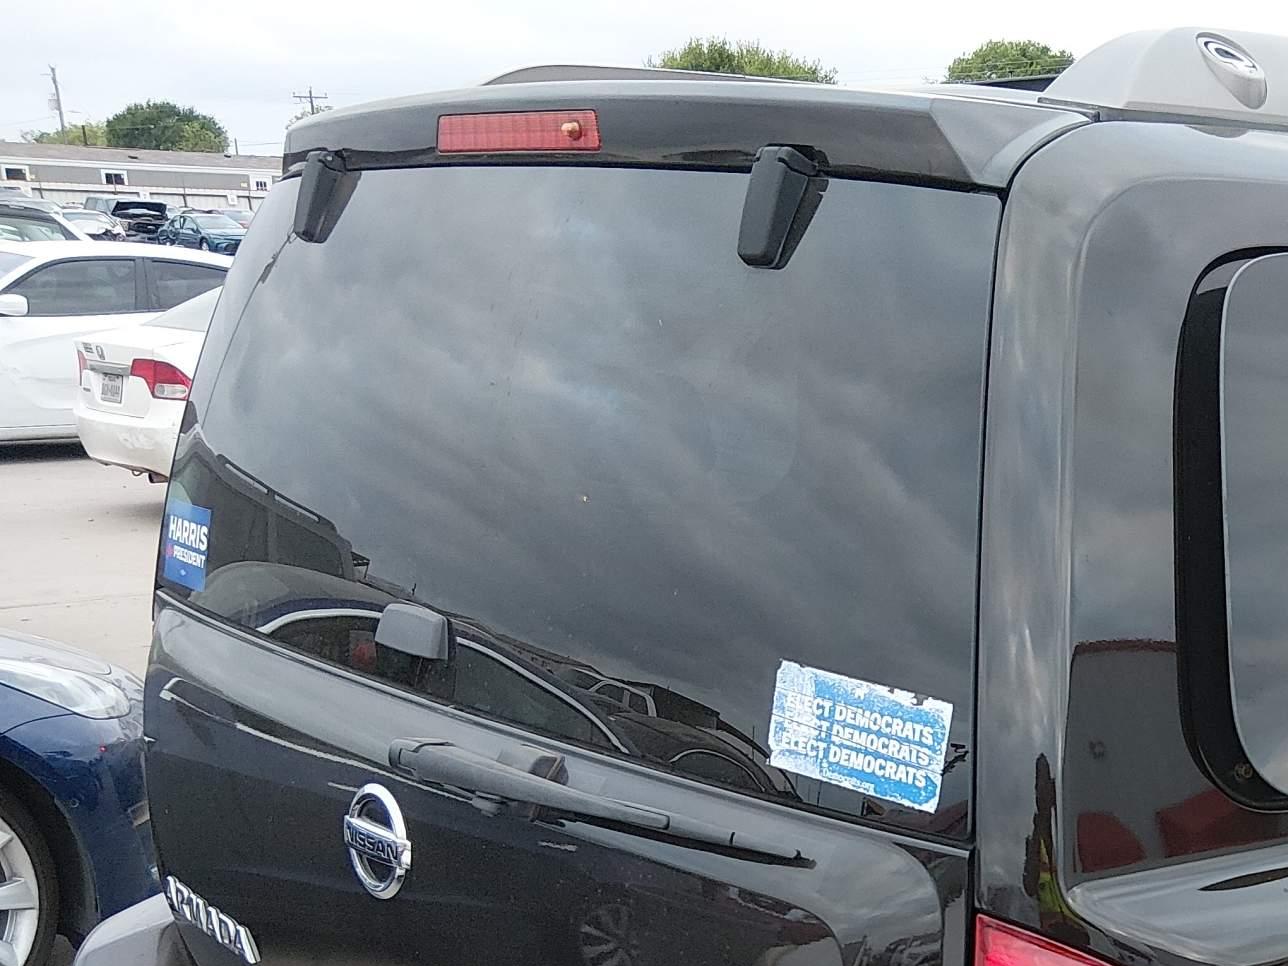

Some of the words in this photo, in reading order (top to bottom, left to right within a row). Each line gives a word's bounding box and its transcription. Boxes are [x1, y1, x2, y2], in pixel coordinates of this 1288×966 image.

[168, 515, 208, 551] HARRIS
[173, 544, 206, 568] PRESIDENT
[831, 724, 930, 766] DEMOCRATS
[835, 703, 934, 745] DEMOCRATS
[781, 730, 827, 759] ELECT
[828, 743, 926, 787] DEMOCRATS
[345, 822, 399, 864] NISSAN
